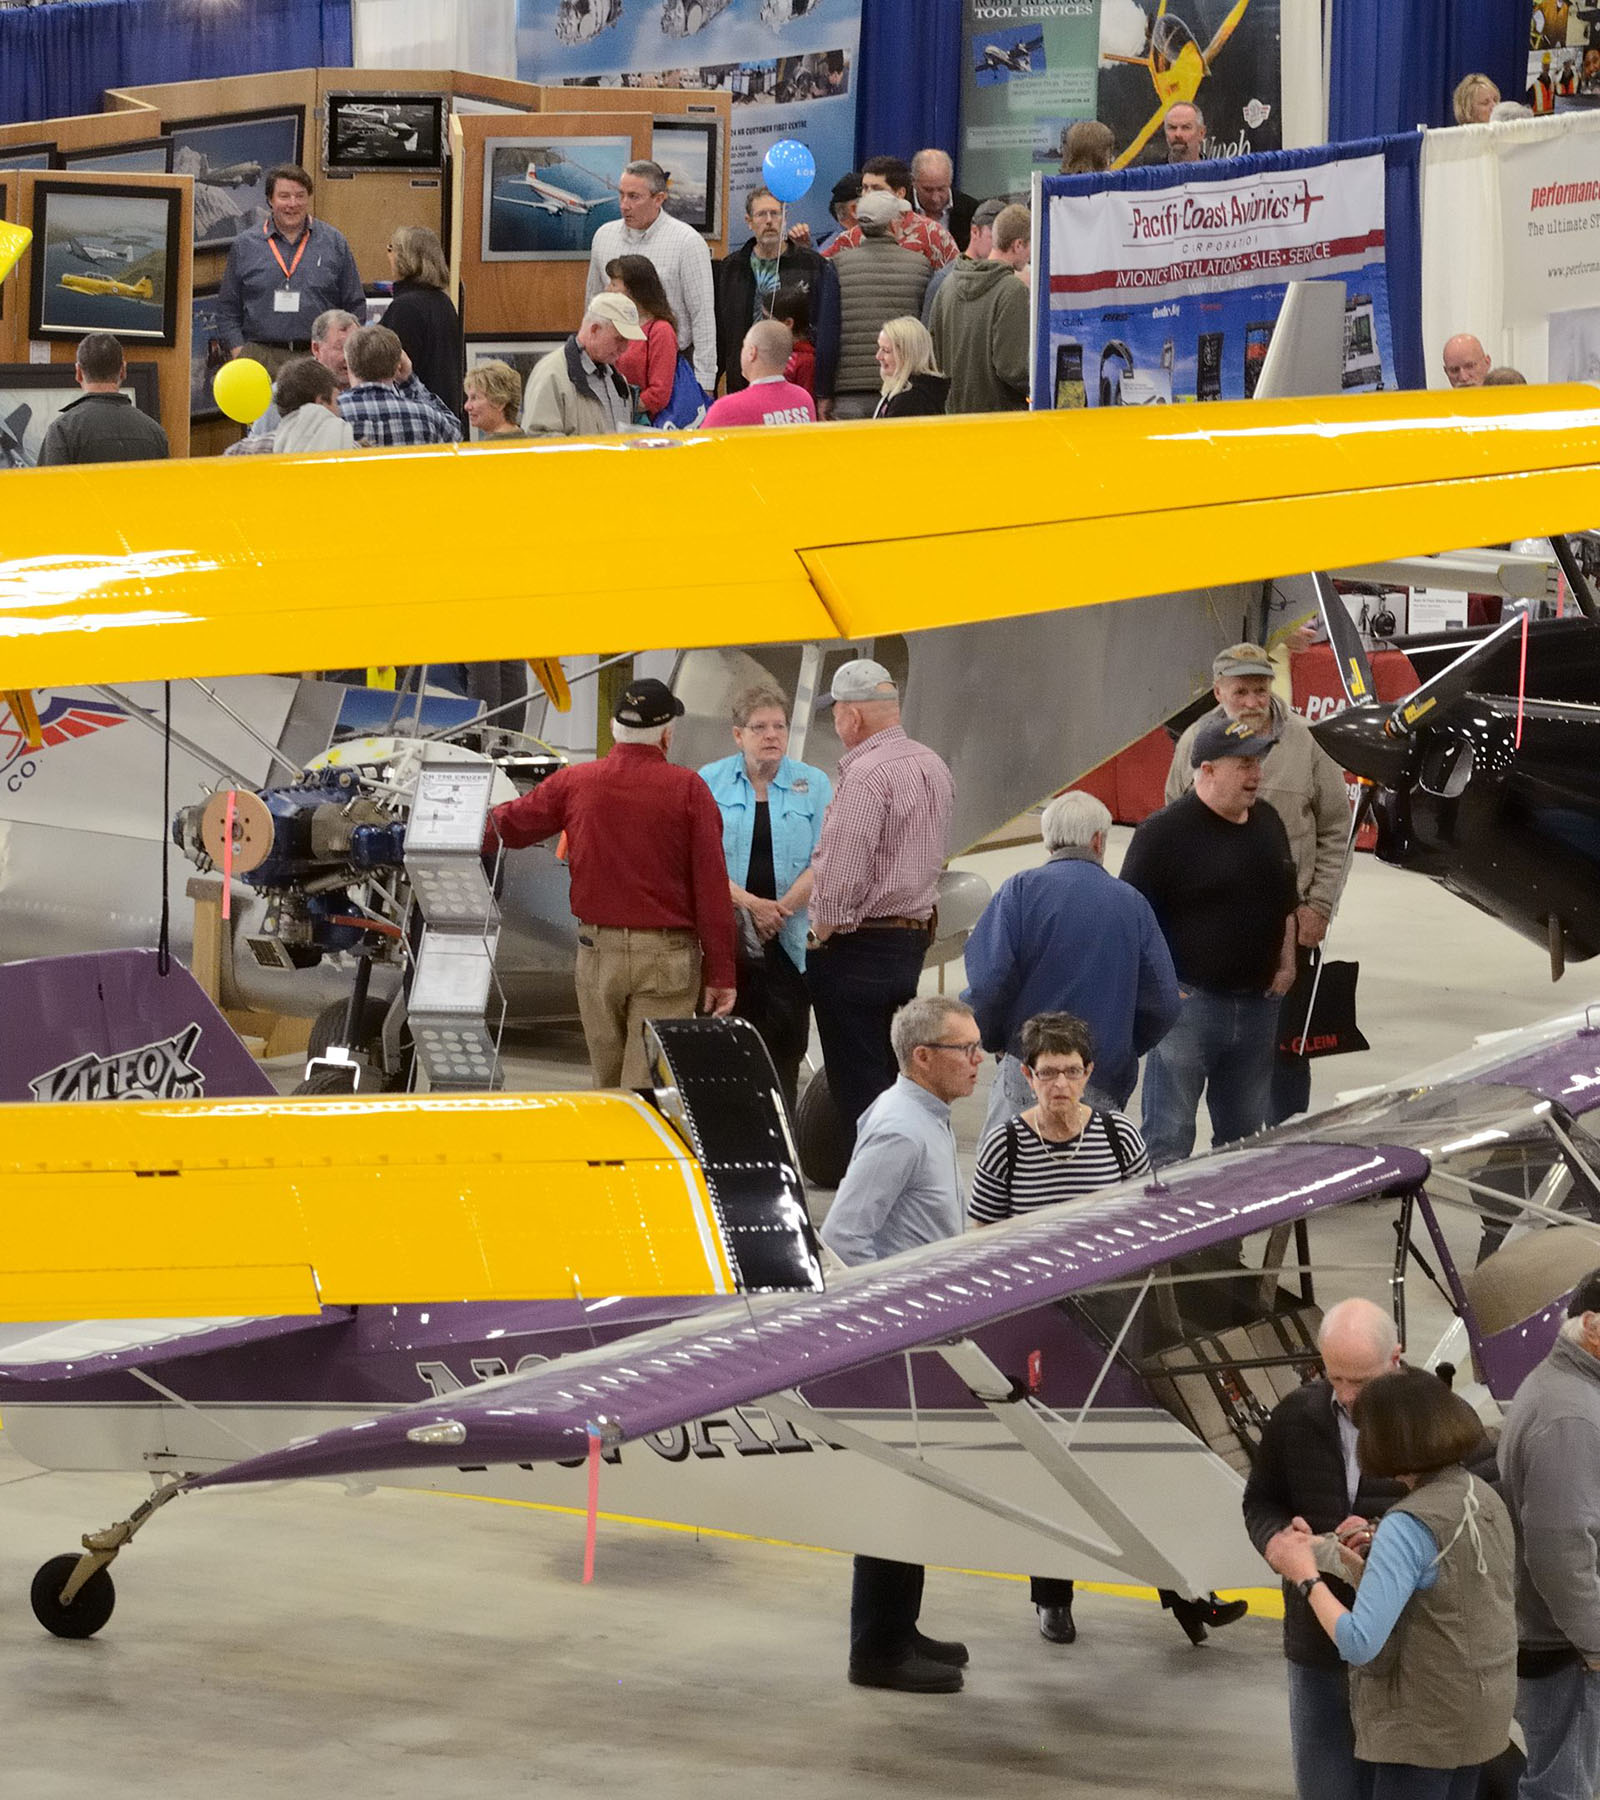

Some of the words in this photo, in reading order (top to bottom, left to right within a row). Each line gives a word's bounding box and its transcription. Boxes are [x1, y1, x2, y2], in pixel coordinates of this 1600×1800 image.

[975, 7, 1018, 18] TOOL
[1021, 5, 1093, 17] SERVICES
[1132, 203, 1178, 239] Pacifi
[1183, 198, 1229, 230] Coast
[1231, 189, 1290, 227] Avionics
[1528, 221, 1545, 237] The
[1547, 217, 1588, 235] ultimate
[1182, 234, 1259, 254] CRPORATIO
[1115, 269, 1168, 287] AVIONICS
[1250, 249, 1281, 269] SALES
[1288, 242, 1331, 265] SERICE
[763, 406, 810, 425] PRESS
[29, 1022, 205, 1101] KITFOX
